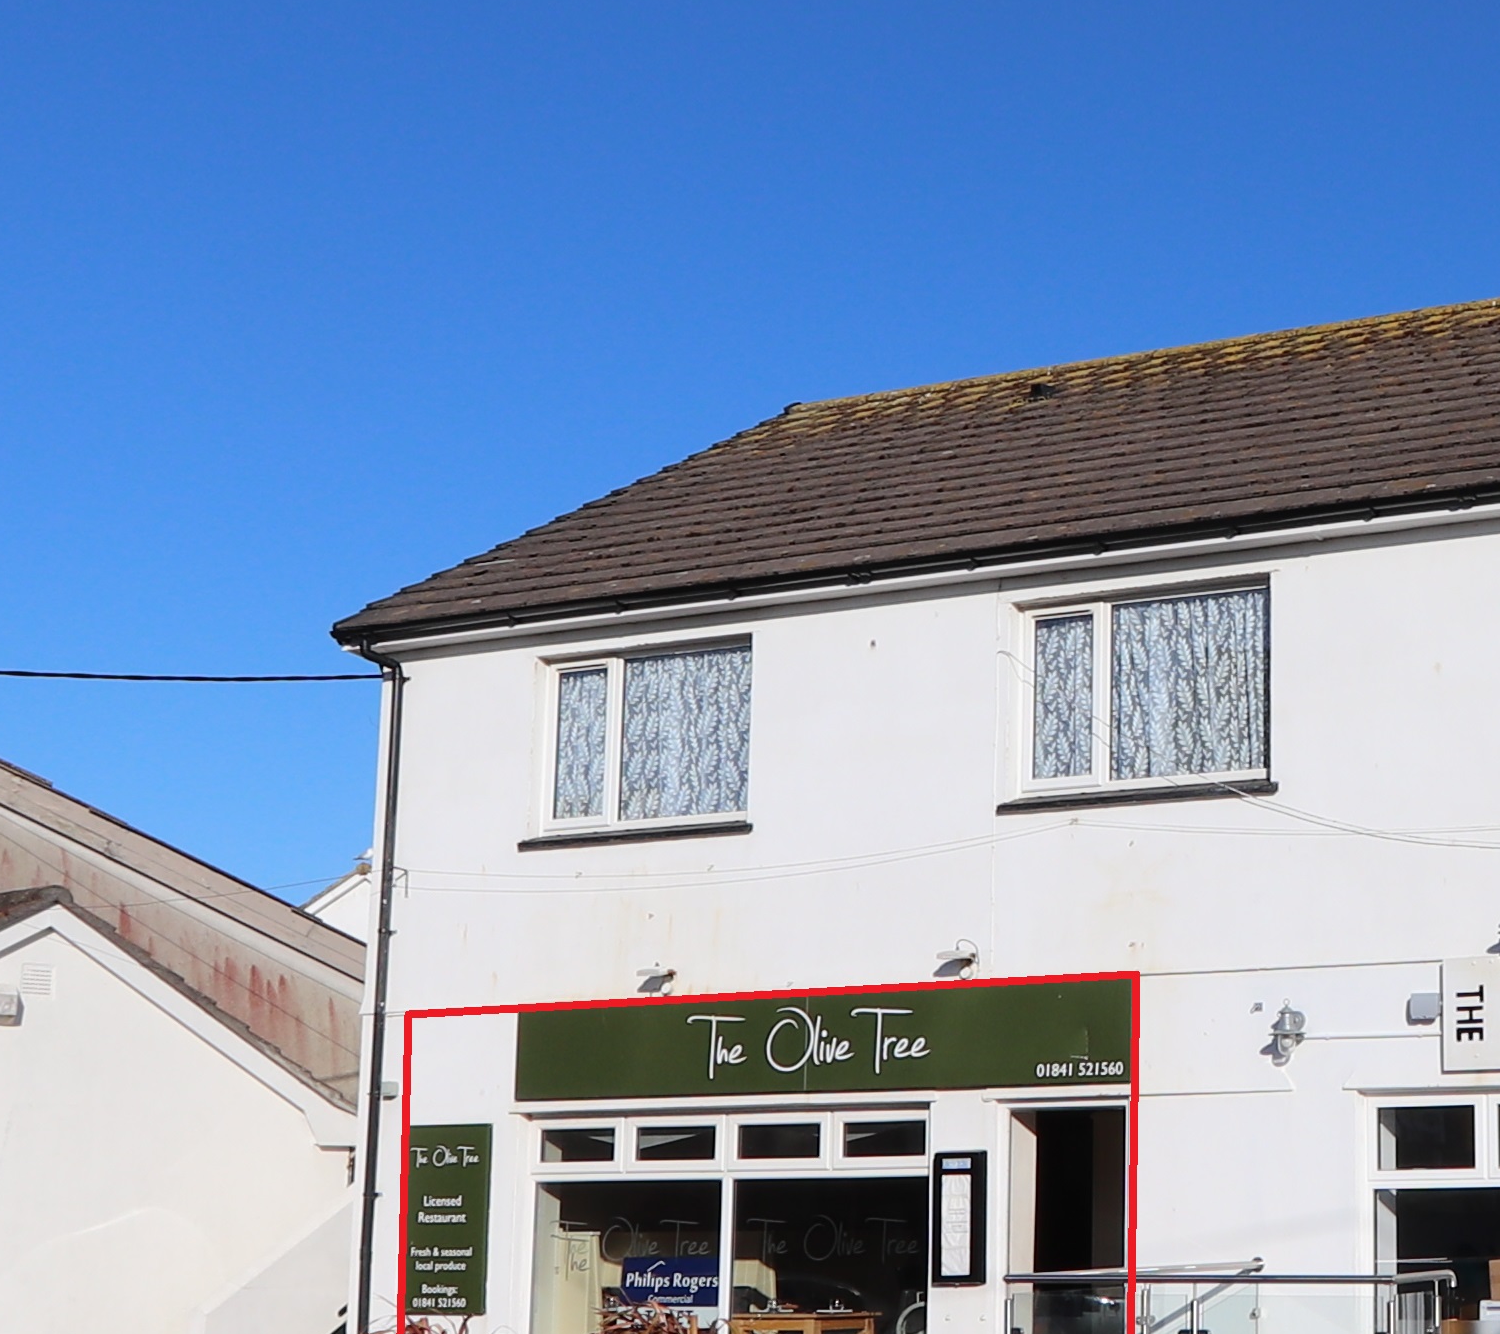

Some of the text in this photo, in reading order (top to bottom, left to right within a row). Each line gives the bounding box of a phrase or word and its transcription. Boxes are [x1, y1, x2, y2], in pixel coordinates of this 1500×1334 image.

[1456, 985, 1484, 1042] THE
[686, 1006, 931, 1080] The Olive Tree
[1036, 1061, 1124, 1078] 01841 521560
[410, 1145, 480, 1168] The Olive Tree
[423, 1195, 463, 1207] Licensed
[417, 1212, 467, 1223] Restaurant
[602, 1216, 660, 1262] Olive
[660, 1219, 712, 1259] Tree
[746, 1218, 789, 1264] The
[804, 1214, 866, 1261] Olive
[865, 1217, 920, 1264] Tree
[410, 1246, 473, 1257] Fresh & seasonal
[415, 1260, 466, 1273] local produce
[421, 1284, 459, 1296] Bookings:
[672, 1272, 719, 1293] Rogers
[412, 1297, 467, 1308] 01841 521560
[647, 1294, 694, 1303] Commercial
